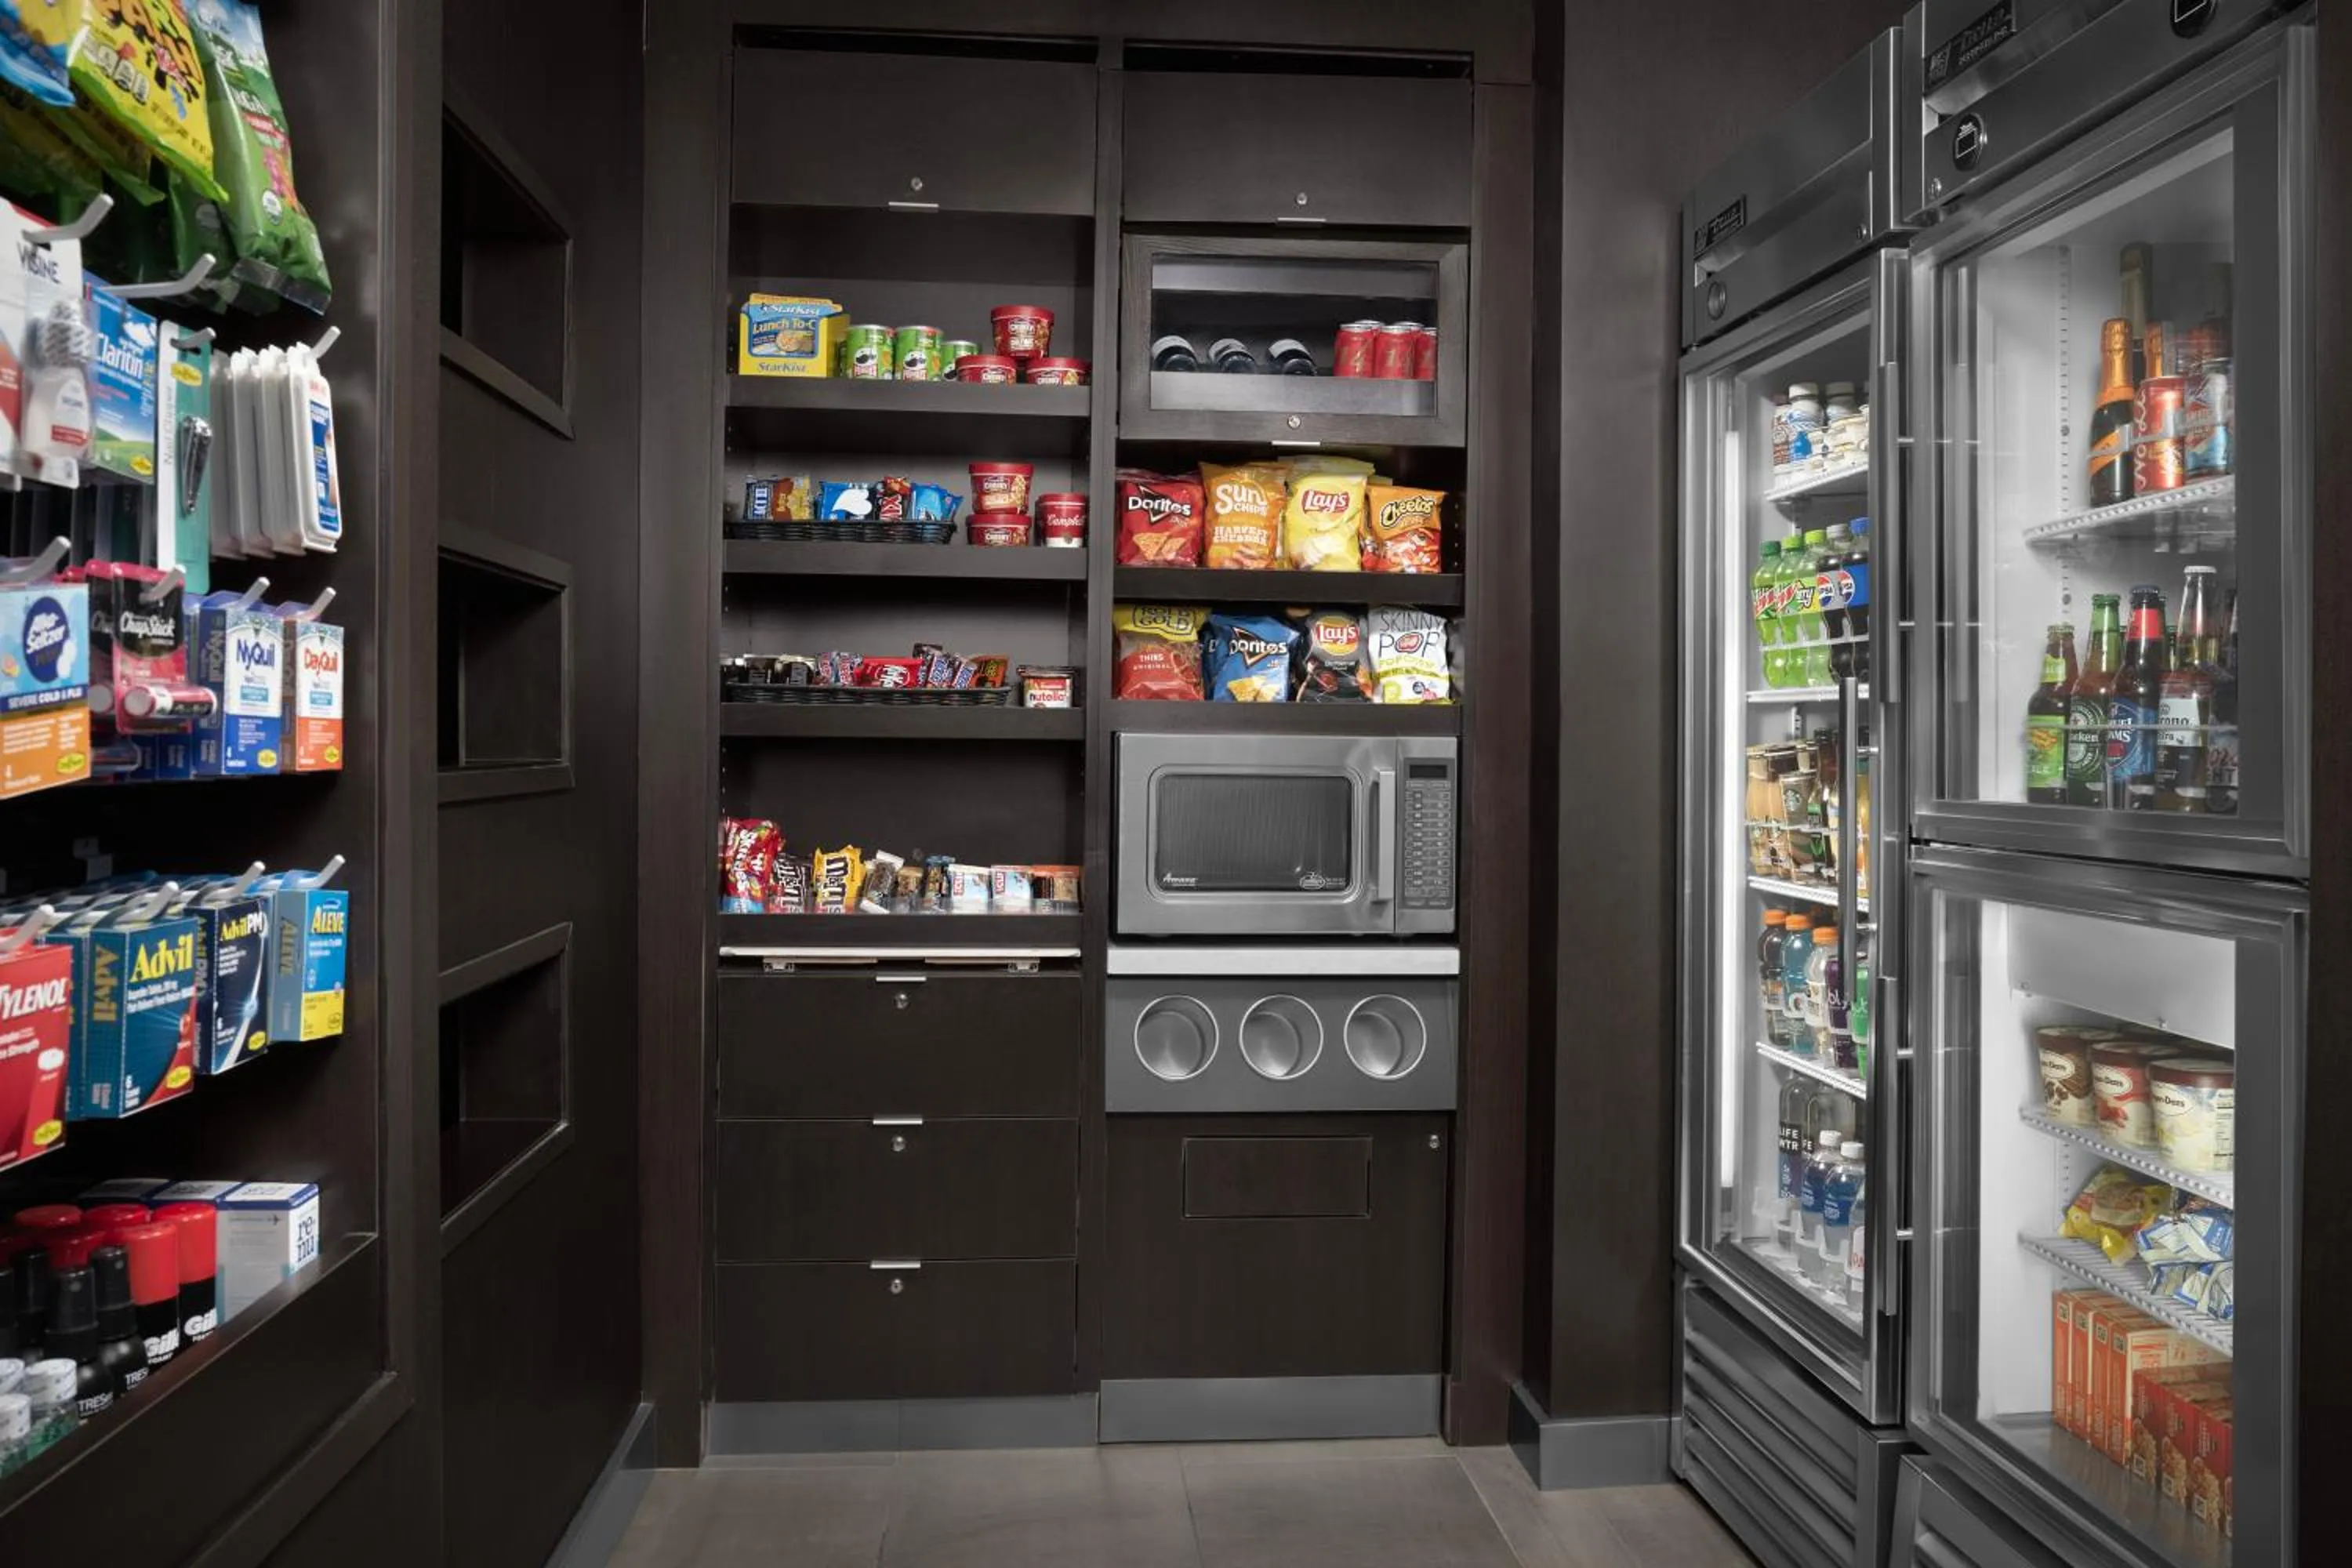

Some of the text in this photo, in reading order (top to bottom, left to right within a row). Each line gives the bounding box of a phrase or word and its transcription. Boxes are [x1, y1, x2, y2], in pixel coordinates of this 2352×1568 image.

[1128, 495, 1192, 516] Doritos
[1215, 483, 1269, 515] Sun
[1233, 503, 1269, 517] CHIPS
[1380, 495, 1435, 528] Cheetos
[120, 611, 176, 638] ChapStick
[1138, 614, 1190, 631] GOLD
[1319, 623, 1356, 644] Lay's
[1380, 609, 1444, 632] SKINNY
[237, 639, 275, 670] NyQuil
[1139, 653, 1164, 662] THINS
[1229, 639, 1287, 655] Doritos
[303, 648, 339, 677] DayQuil
[1029, 691, 1066, 703] nutella
[220, 910, 263, 942] Advil PM
[311, 905, 345, 934] ALEVE
[129, 933, 194, 983] Advil
[93, 944, 119, 1022] Advil
[0, 978, 69, 1019] TYLENOL
